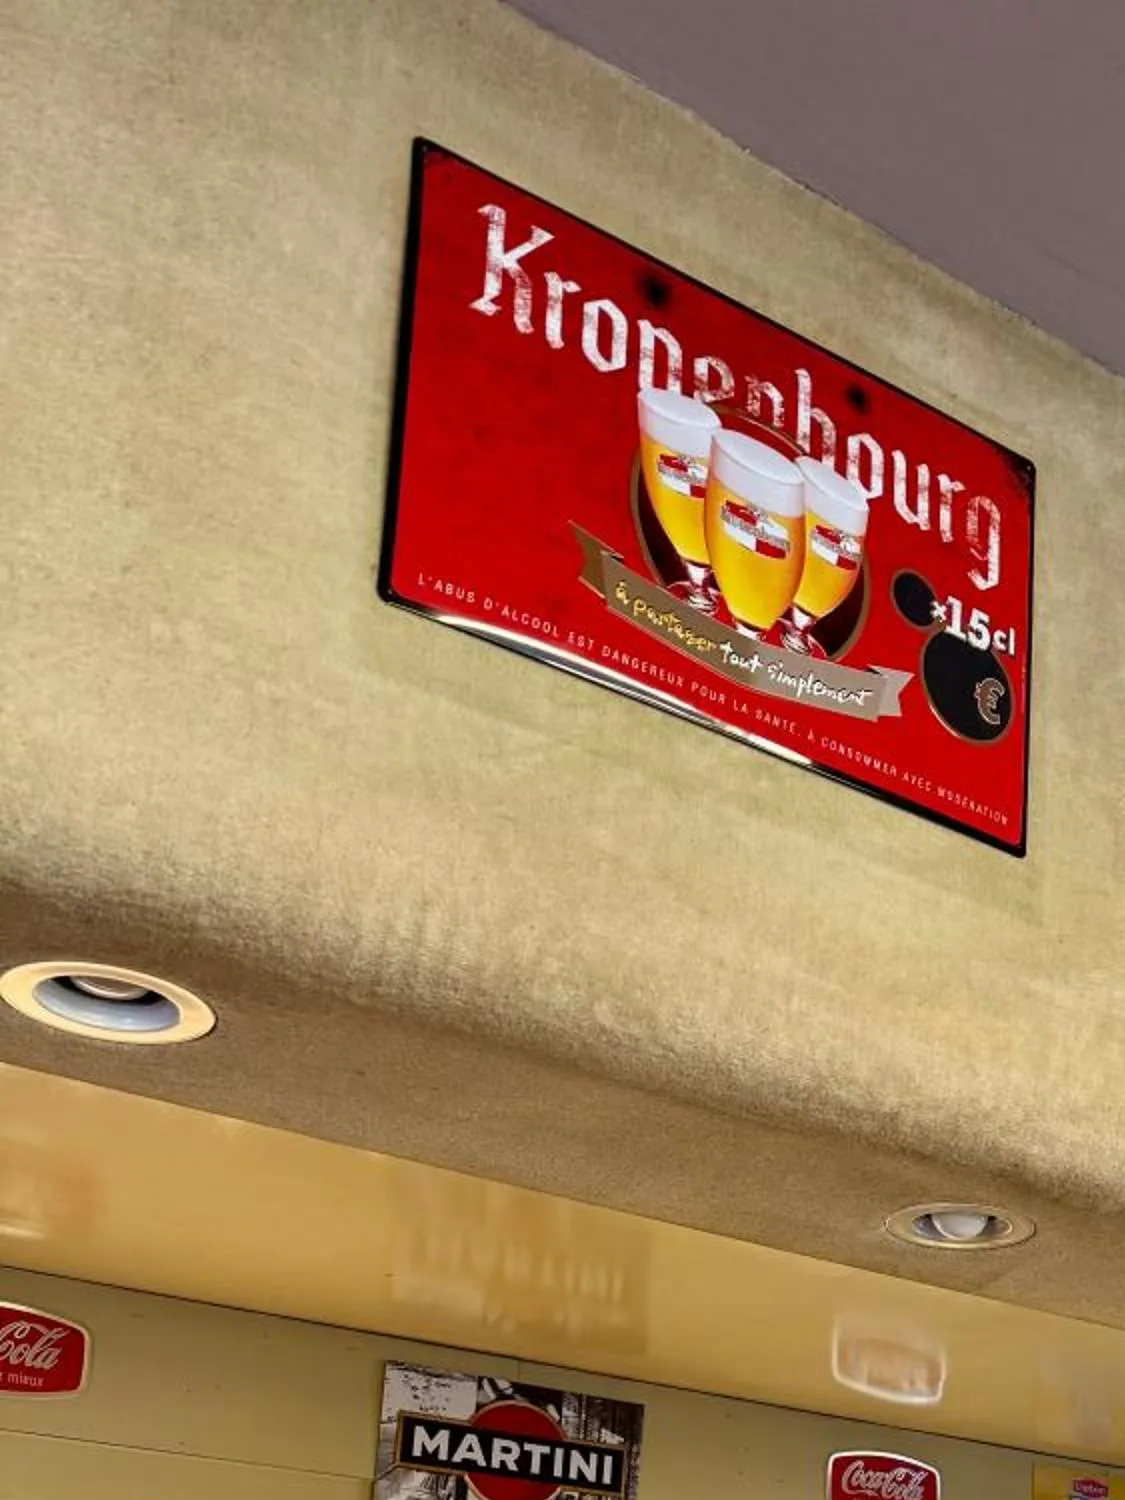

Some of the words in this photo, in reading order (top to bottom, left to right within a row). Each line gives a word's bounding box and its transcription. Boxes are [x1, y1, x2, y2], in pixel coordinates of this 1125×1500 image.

[469, 204, 1002, 590] Kronenbourg
[417, 572, 476, 603] L'ABUS
[483, 596, 560, 638] D'ALCOOL
[567, 630, 595, 652] EST
[601, 643, 684, 687] DANGEREUX
[691, 679, 727, 705] POUR
[733, 698, 749, 715] LA
[902, 771, 932, 792] AVEC
[719, 641, 764, 673] tout
[767, 661, 873, 707] simplement
[410, 1424, 615, 1486] MARTINI
